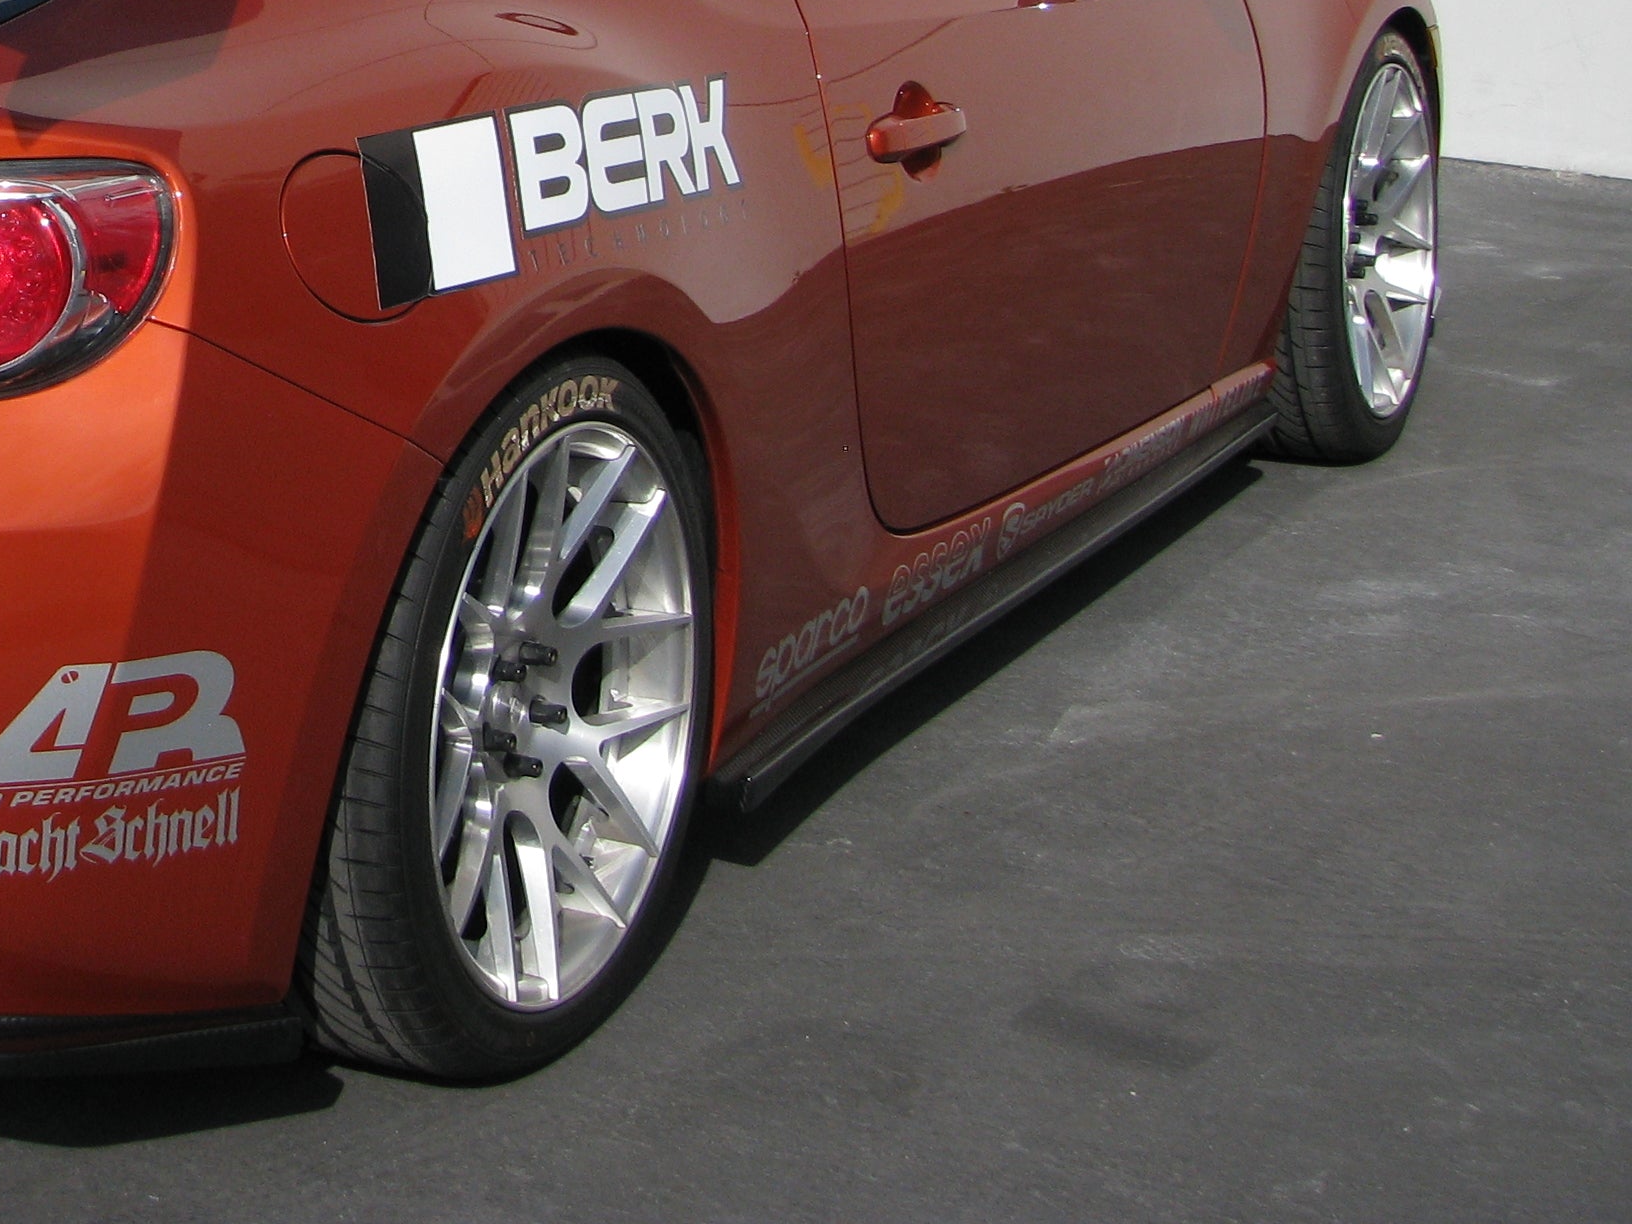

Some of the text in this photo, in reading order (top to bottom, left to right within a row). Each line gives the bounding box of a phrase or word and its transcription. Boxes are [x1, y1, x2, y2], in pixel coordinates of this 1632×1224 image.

[506, 75, 744, 235] BERK
[754, 585, 870, 714] sparco
[10, 762, 246, 808] PERFORMANCE
[80, 786, 241, 867] Schnell
